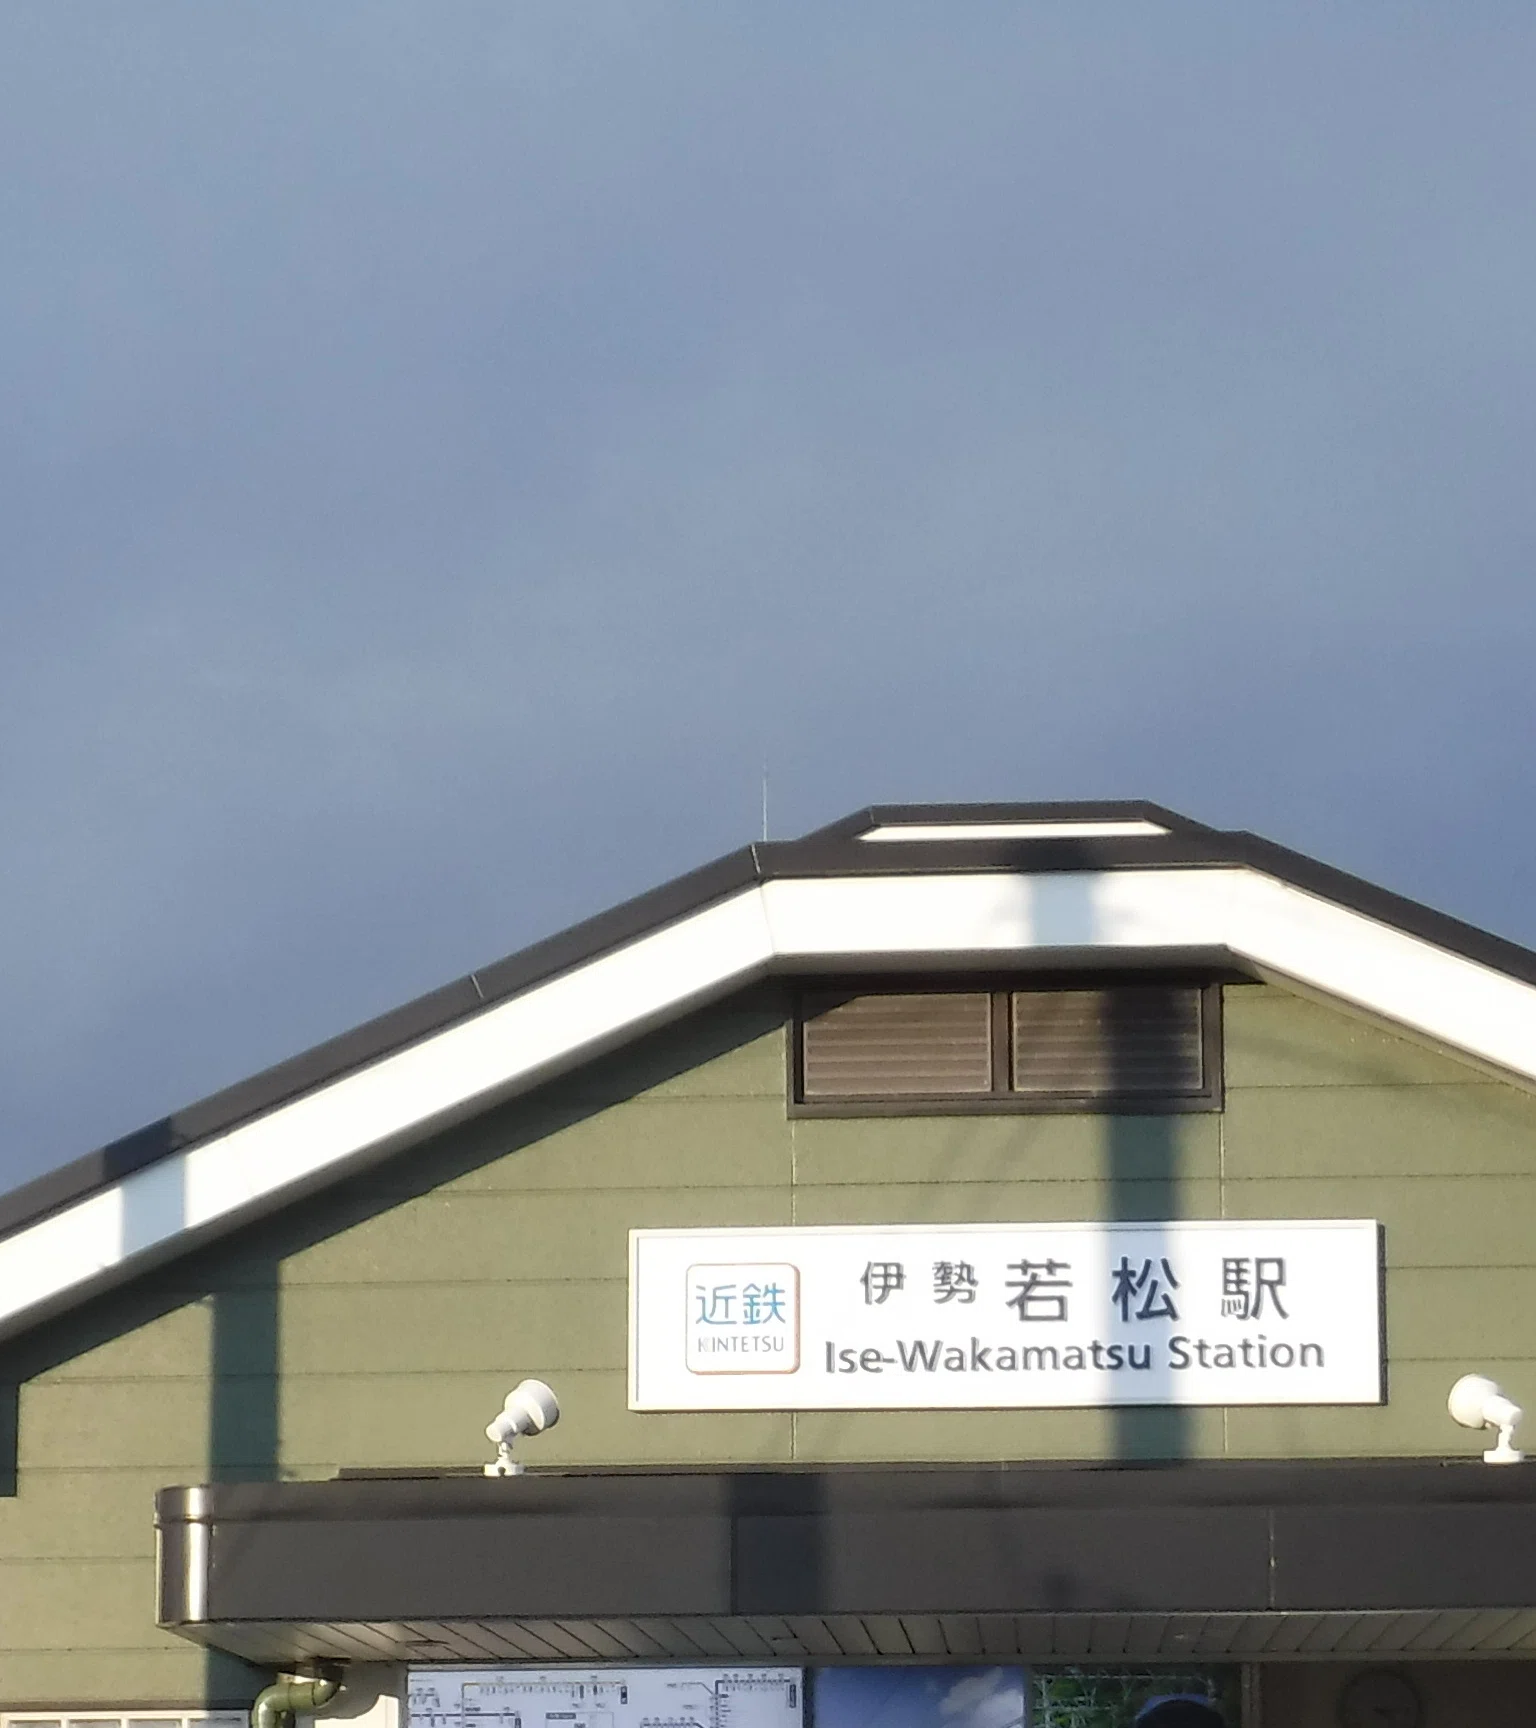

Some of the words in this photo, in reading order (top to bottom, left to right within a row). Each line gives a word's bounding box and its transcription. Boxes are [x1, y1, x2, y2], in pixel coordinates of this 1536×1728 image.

[695, 1282, 786, 1325] 近鉄
[860, 1256, 1291, 1322] 伊勢若松駅
[697, 1335, 784, 1353] KINTETSU
[825, 1337, 1152, 1374] Ise-Wakamatsu
[1168, 1334, 1325, 1370] Station
